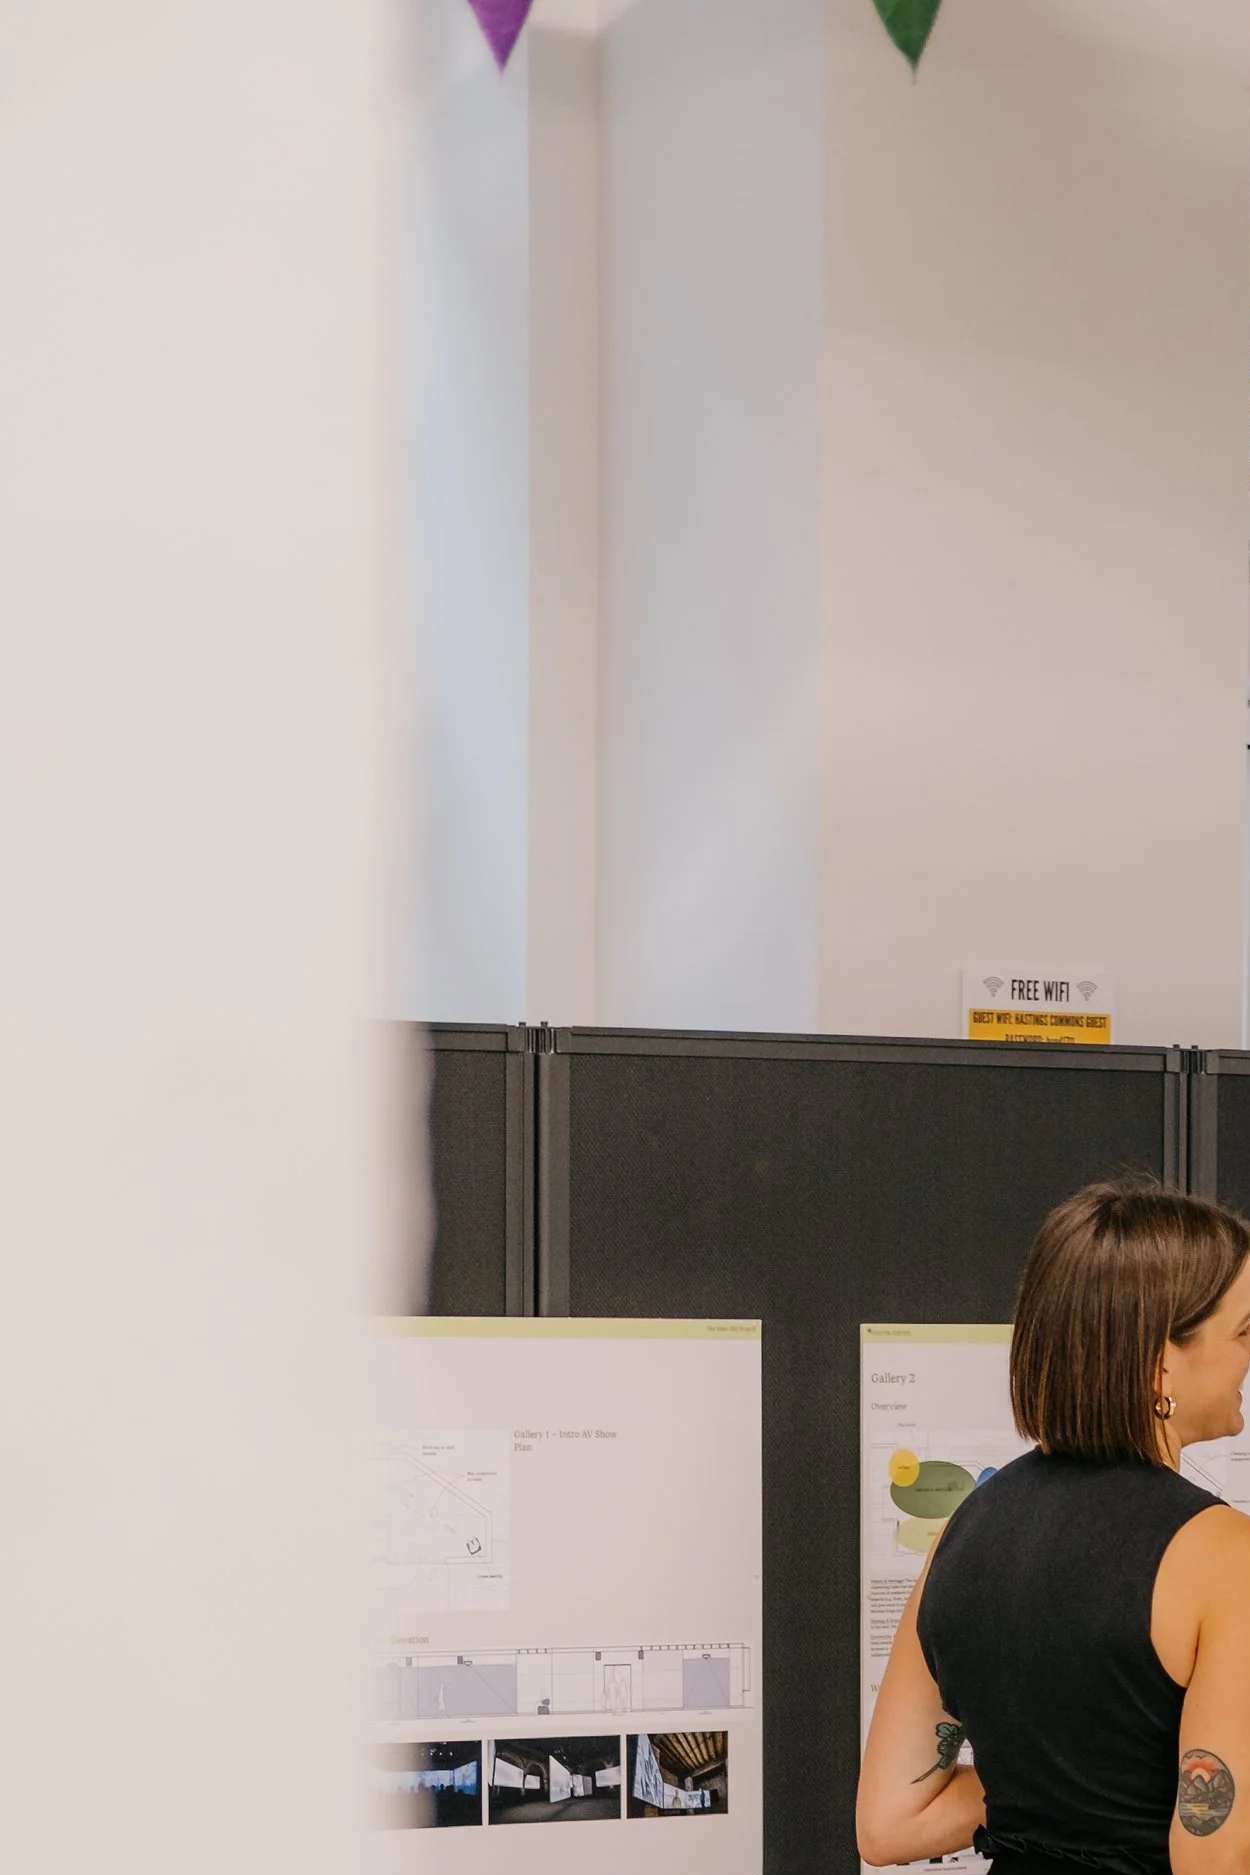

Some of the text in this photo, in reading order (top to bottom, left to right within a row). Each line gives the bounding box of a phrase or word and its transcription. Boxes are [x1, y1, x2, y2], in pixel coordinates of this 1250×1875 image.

[1011, 979, 1070, 1002] FREE WIFI
[973, 1011, 994, 1024] GUEST
[1015, 1013, 1048, 1026] HASTINGS
[1050, 1014, 1083, 1028] COMMONS
[1086, 1016, 1106, 1029] GUEST
[871, 1373, 916, 1386] Gallery 2
[871, 1402, 908, 1411] Overview
[513, 1430, 543, 1441] Gallery
[559, 1430, 580, 1439] Intro
[581, 1430, 593, 1439] AV
[594, 1430, 617, 1439] Show
[513, 1443, 532, 1452] Plan
